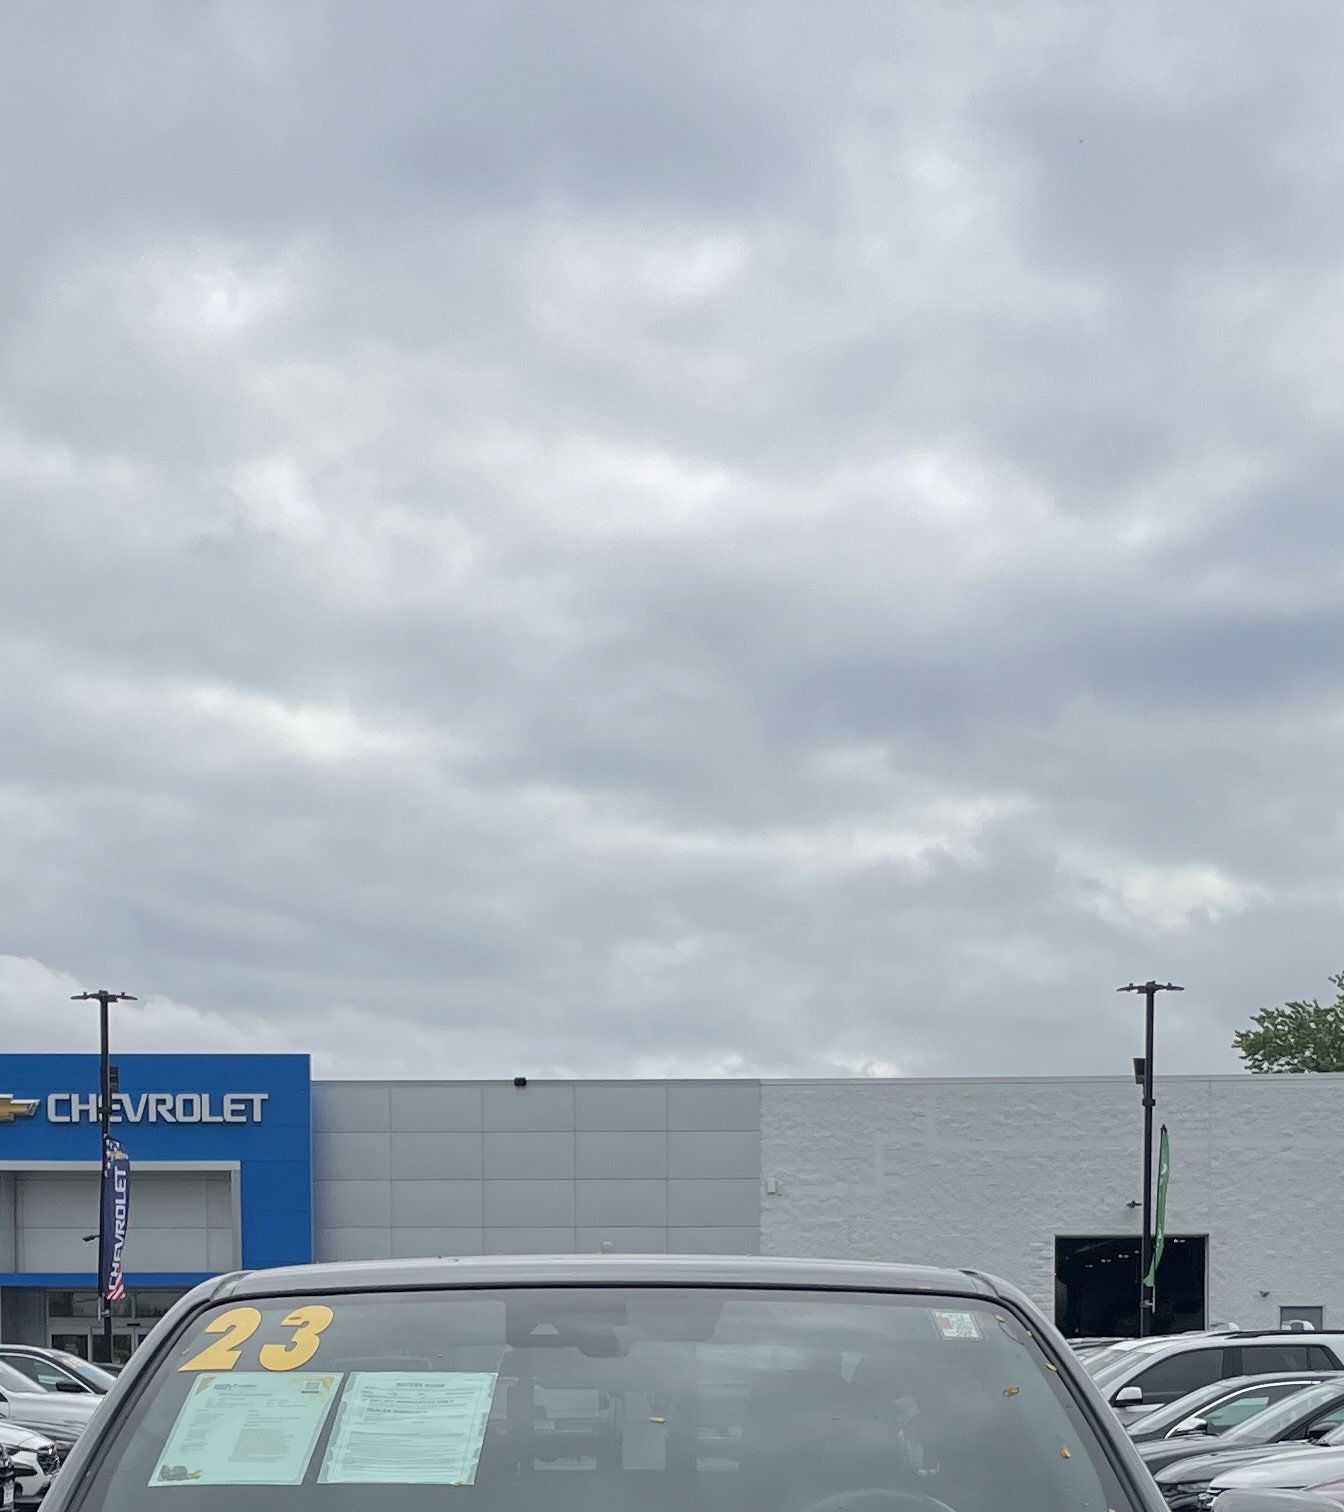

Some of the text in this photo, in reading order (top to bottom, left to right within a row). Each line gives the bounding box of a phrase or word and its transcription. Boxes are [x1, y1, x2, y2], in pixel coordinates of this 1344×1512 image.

[47, 1093, 269, 1123] CHEVROLET
[108, 1166, 128, 1290] CHEVROLET
[178, 1305, 334, 1371] 23
